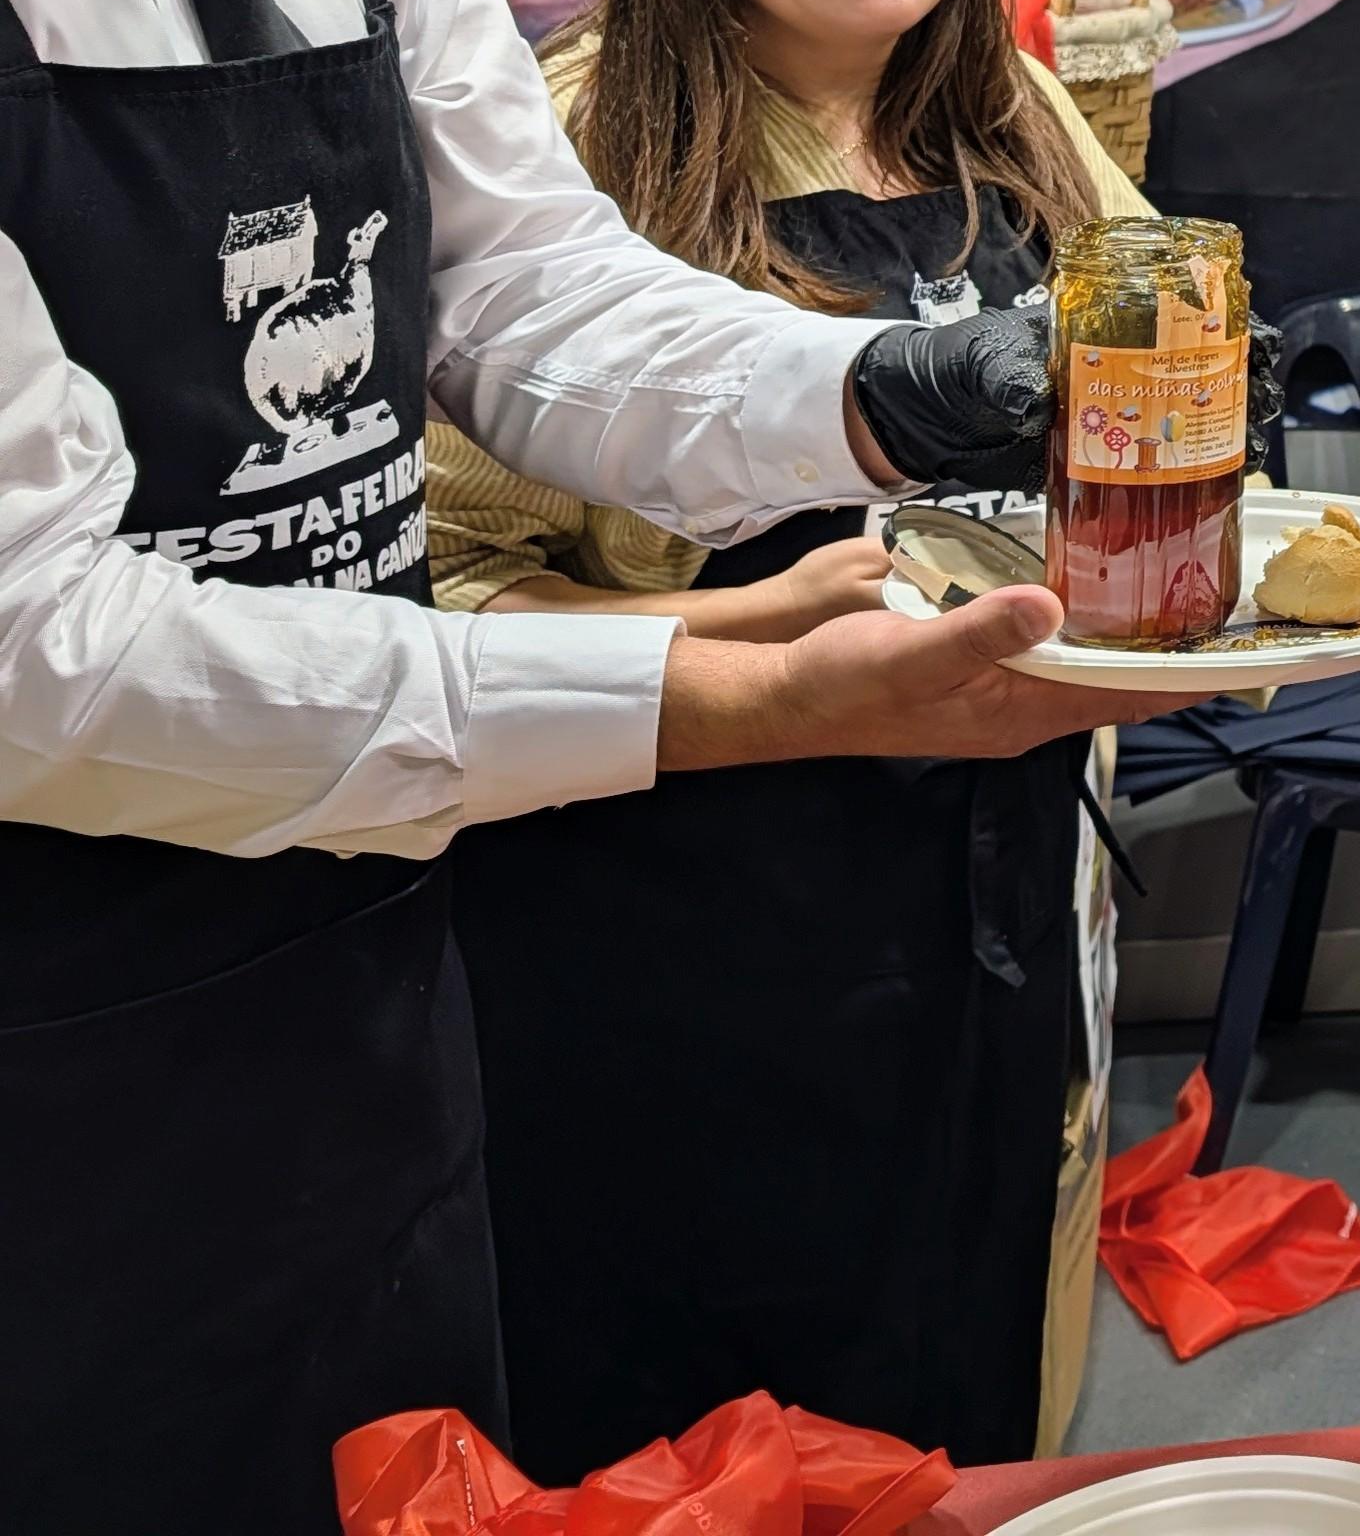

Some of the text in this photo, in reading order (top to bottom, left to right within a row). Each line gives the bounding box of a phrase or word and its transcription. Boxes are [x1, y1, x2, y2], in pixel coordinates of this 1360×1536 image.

[1152, 355, 1173, 366] Mel
[1177, 354, 1190, 364] de
[1088, 378, 1126, 398] das
[311, 530, 362, 567] DO
